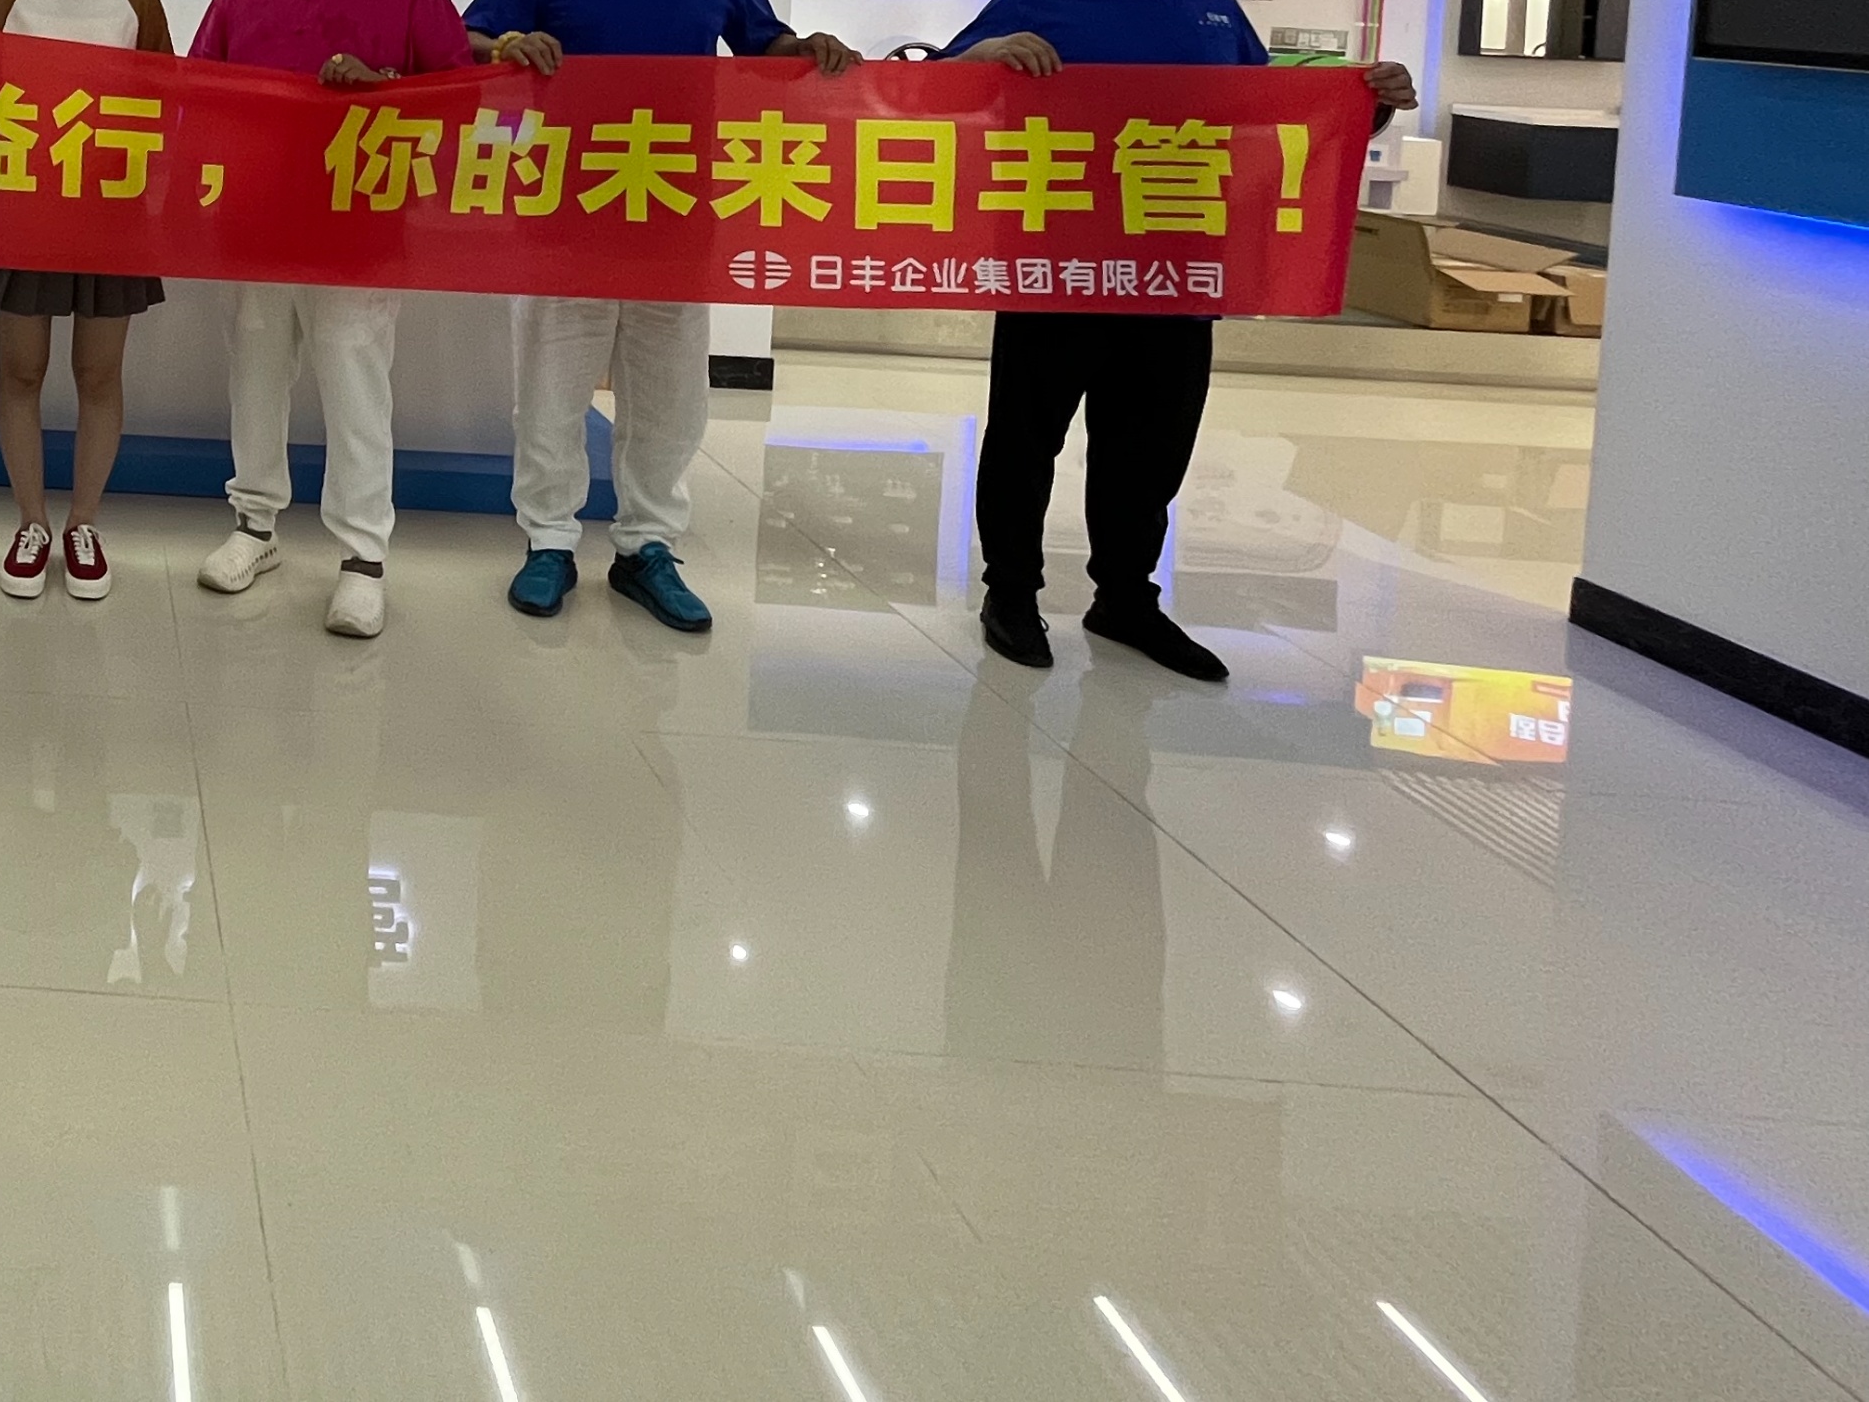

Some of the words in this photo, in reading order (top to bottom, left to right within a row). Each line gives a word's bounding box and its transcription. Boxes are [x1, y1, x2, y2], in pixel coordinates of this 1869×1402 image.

[809, 254, 1225, 299] 日丰企业集团有限公司
